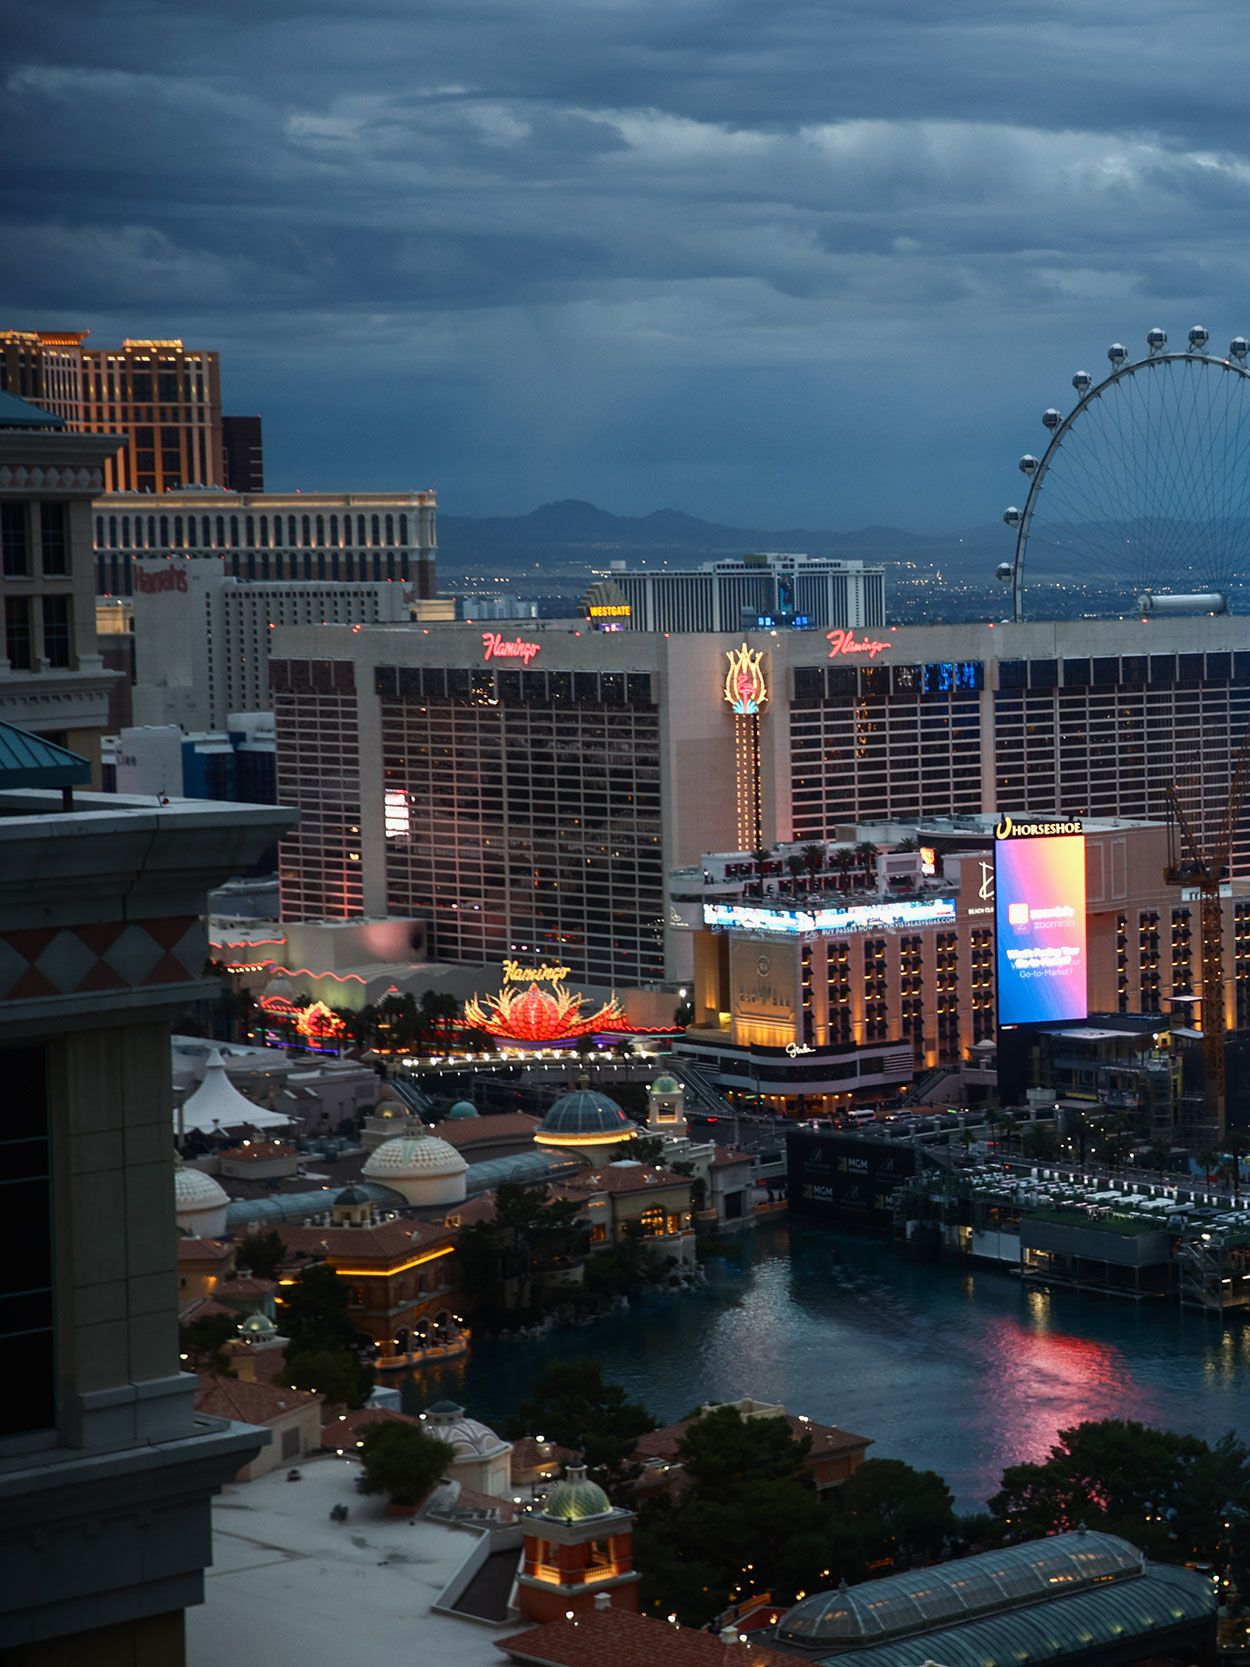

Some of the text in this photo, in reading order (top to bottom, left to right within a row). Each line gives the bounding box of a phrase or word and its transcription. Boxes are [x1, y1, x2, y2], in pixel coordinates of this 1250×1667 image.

[590, 606, 631, 616] WESTGATE
[481, 632, 541, 665] Flamingo
[826, 629, 892, 658] Flamingo
[1012, 822, 1082, 836] HORSESHOE
[502, 960, 571, 986] Flamingo
